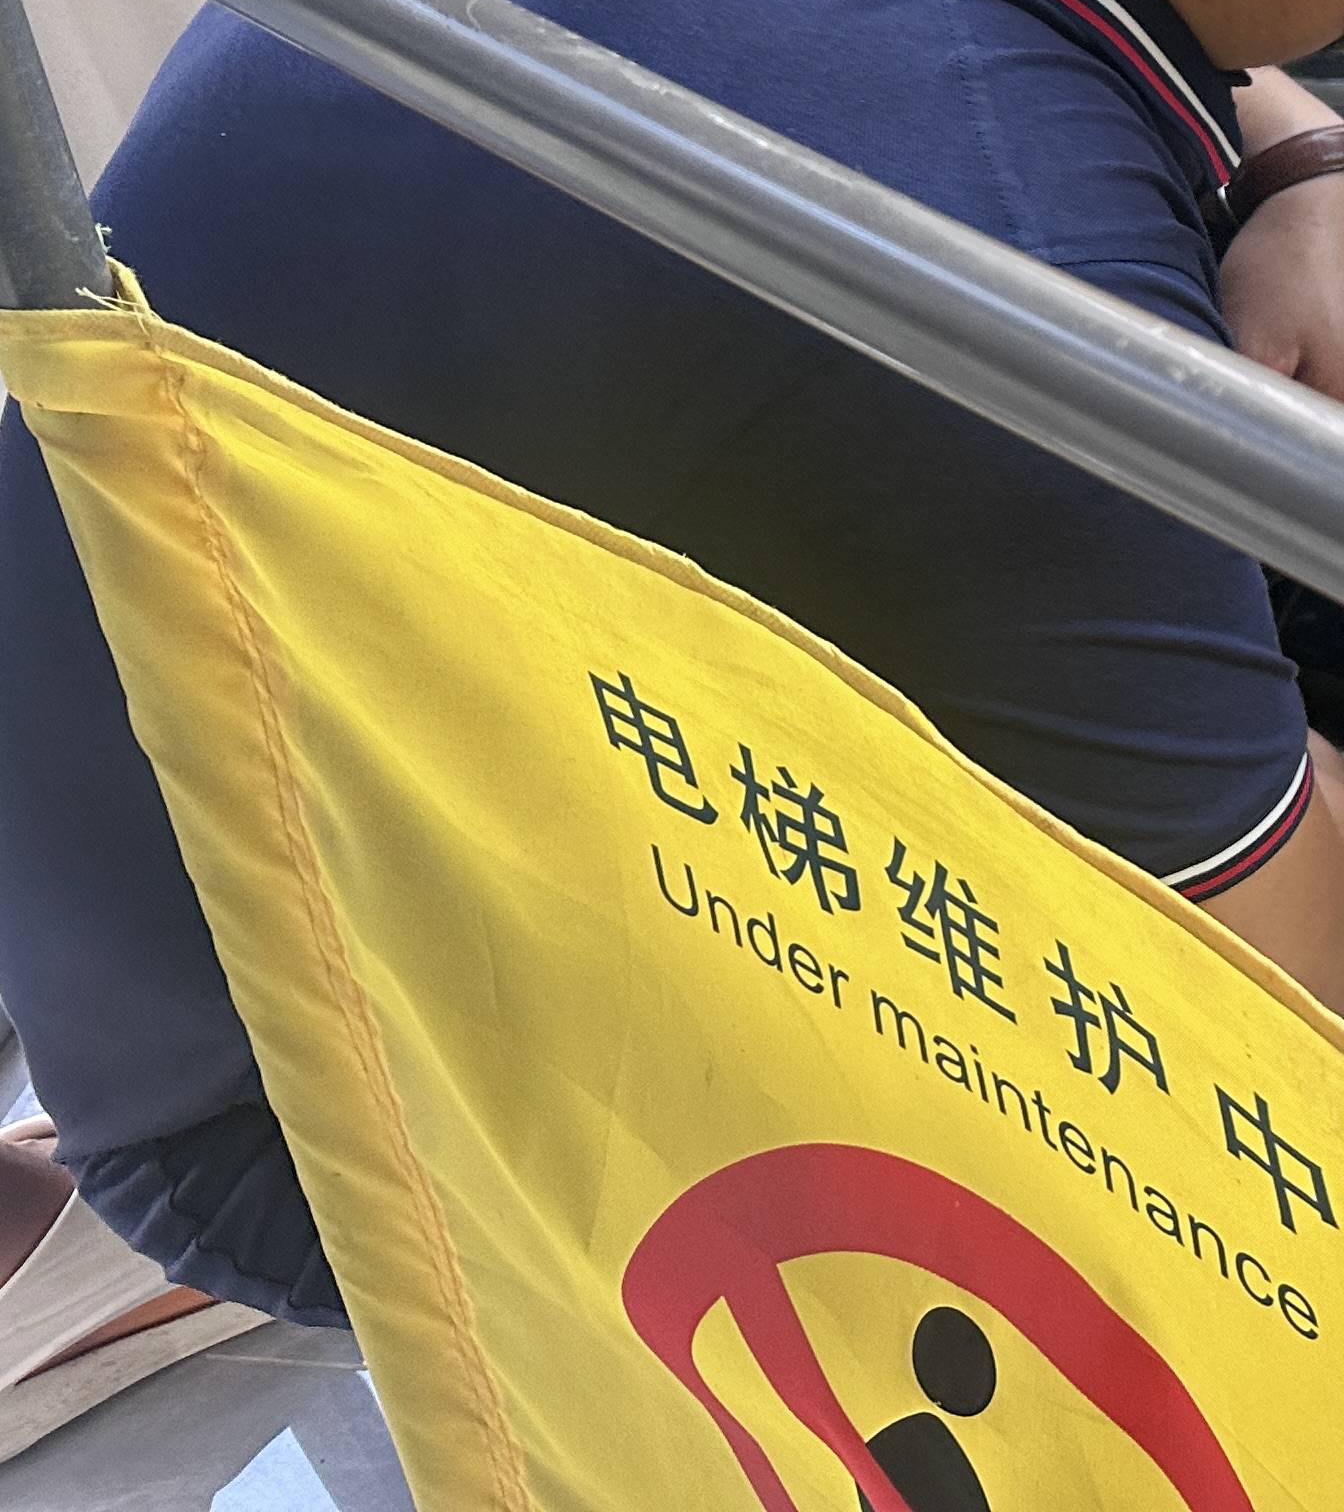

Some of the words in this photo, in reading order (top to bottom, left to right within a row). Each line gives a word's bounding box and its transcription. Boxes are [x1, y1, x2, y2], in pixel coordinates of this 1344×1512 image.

[589, 671, 1340, 1233] 电梯维护中
[651, 843, 850, 1009] Under
[871, 988, 1319, 1340] maintenance
